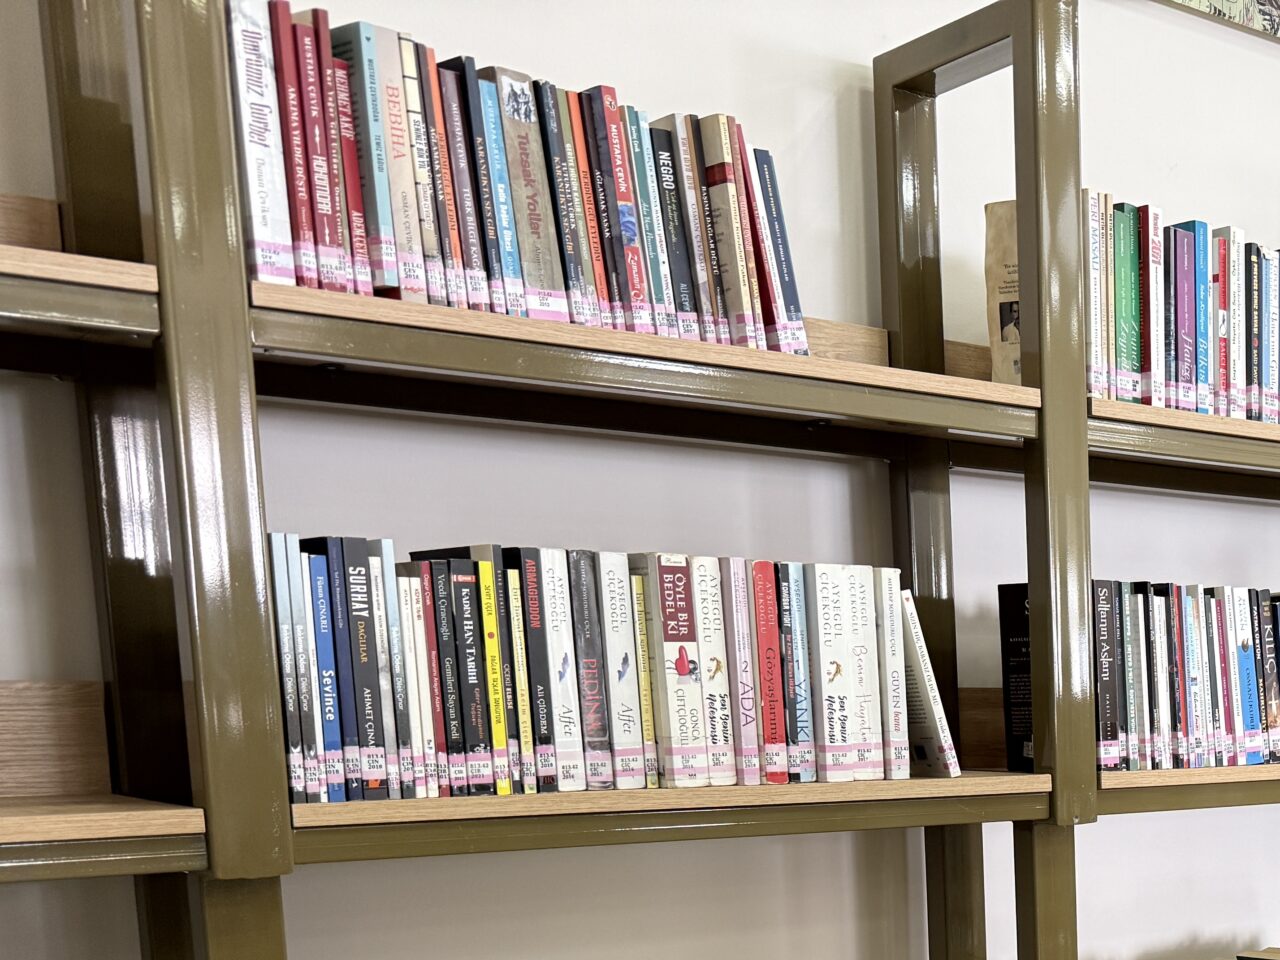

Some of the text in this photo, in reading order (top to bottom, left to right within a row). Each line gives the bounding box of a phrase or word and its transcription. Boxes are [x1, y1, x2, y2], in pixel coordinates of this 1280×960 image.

[304, 36, 316, 86] MUSTAFA
[287, 84, 301, 126] AKLIMA
[336, 69, 351, 114] MEHMET
[247, 101, 273, 148] Gurbet
[384, 84, 406, 160] BEBİHA
[610, 124, 623, 165] MUSTAFA
[292, 130, 305, 164] YILDIZ
[516, 133, 543, 239] Tutsak Yollar
[659, 151, 674, 189] NEGRO
[351, 210, 364, 236] ADEM
[349, 567, 369, 617] SURHAY
[438, 574, 447, 596] Vecdi
[525, 560, 541, 628] ARMAGEDDON
[663, 575, 679, 635] BEDEL Kİ
[674, 574, 689, 635] ÖYLE BİR
[464, 621, 475, 644] HAN
[323, 670, 335, 720] Sevince
[364, 688, 373, 719] AHMET
[445, 658, 459, 739] Gemileri Sayan Kedi
[719, 694, 728, 710] Sen
[740, 681, 755, 727] ADA
[838, 695, 847, 711] Sen
[690, 709, 699, 741] GONCA
